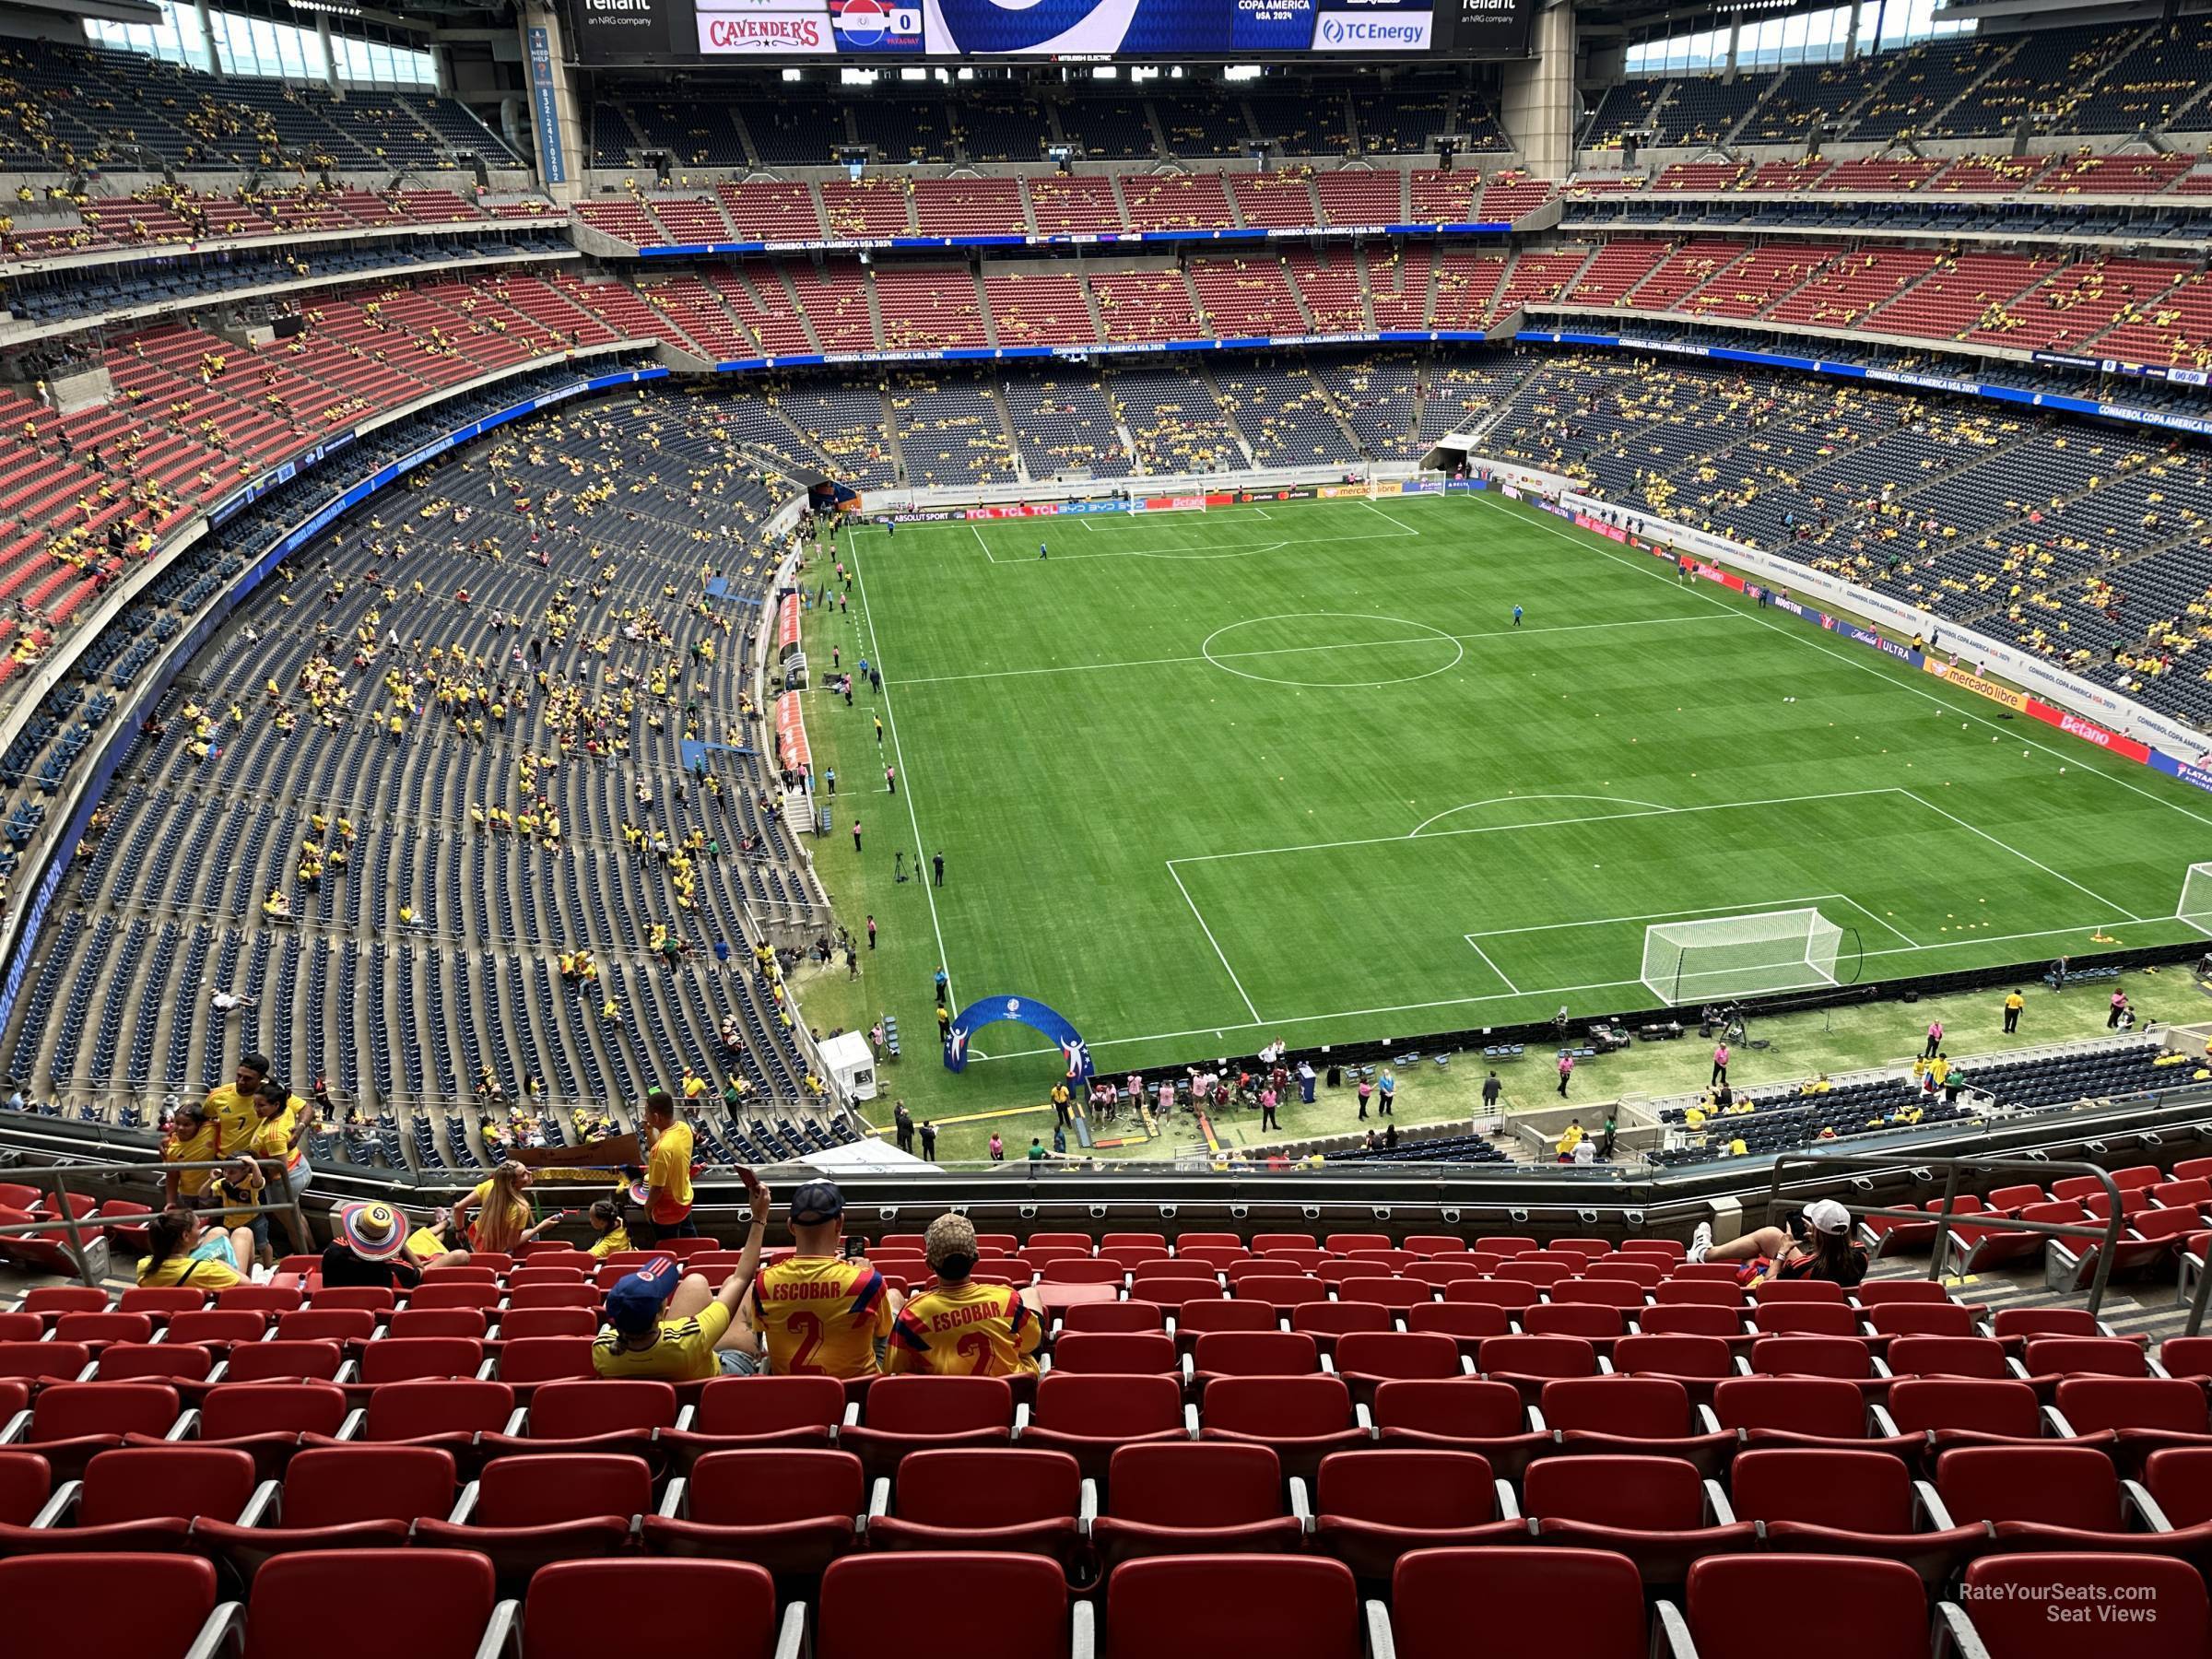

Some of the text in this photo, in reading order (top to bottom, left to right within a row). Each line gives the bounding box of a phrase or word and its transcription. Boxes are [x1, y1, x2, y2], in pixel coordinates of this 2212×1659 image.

[1238, 0, 1310, 9] COPA AMERICA
[598, 17, 617, 25] NRG
[618, 18, 652, 27] company
[900, 14, 912, 30] 0
[1255, 11, 1292, 20] USA 2024
[1470, 15, 1485, 23] NRG
[1485, 16, 1514, 24] company
[710, 18, 819, 47] CAVENDER'S
[1346, 23, 1424, 43] TC Energy
[1305, 228, 1324, 236] COPA
[1324, 228, 1354, 236] AMERICA
[806, 241, 827, 250] COPA
[826, 241, 860, 249] AMERICA
[1305, 336, 1322, 345] COPA
[1321, 335, 1350, 344] AMERICA
[862, 354, 882, 362] COPA
[882, 353, 911, 361] AMERICA
[1089, 347, 1106, 355] COPA
[1865, 370, 1900, 381] CONMEBOL
[1900, 373, 1917, 383] COPA
[1917, 377, 1947, 389] AMERICA
[1961, 383, 1979, 394] 2024
[2174, 371, 2199, 382] 00:00
[2099, 405, 2143, 420] CONMEBOL
[2142, 412, 2165, 426] COPA
[2165, 417, 2203, 431] AMERICA
[967, 508, 994, 520] TCL
[999, 507, 1026, 517] TCL
[1031, 505, 1059, 515] TCL
[1059, 504, 1086, 513] BYD
[1088, 503, 1115, 512] BYD
[894, 512, 925, 523] ABSOLUT
[925, 512, 949, 521] SPORT
[1775, 595, 1802, 615] HOUSTON
[1868, 598, 1879, 607] COPA
[1879, 603, 1898, 614] AMERICA
[1883, 640, 1910, 661] ULTRA
[1957, 635, 1969, 644] COPA
[1970, 641, 1989, 653] AMERICA
[1949, 670, 2018, 707] mercado libre
[2028, 665, 2055, 683] CONMEBOL
[2055, 677, 2069, 689] COPA
[2069, 685, 2092, 699] AMERICA
[2059, 714, 2110, 746] Betano
[2137, 715, 2210, 755] CONMEBOL COPA AMERICA
[238, 1116, 247, 1131] 7
[773, 1281, 841, 1300] ESCOBAR
[932, 1301, 1002, 1334] ESCOBAR
[786, 1311, 828, 1375] 2
